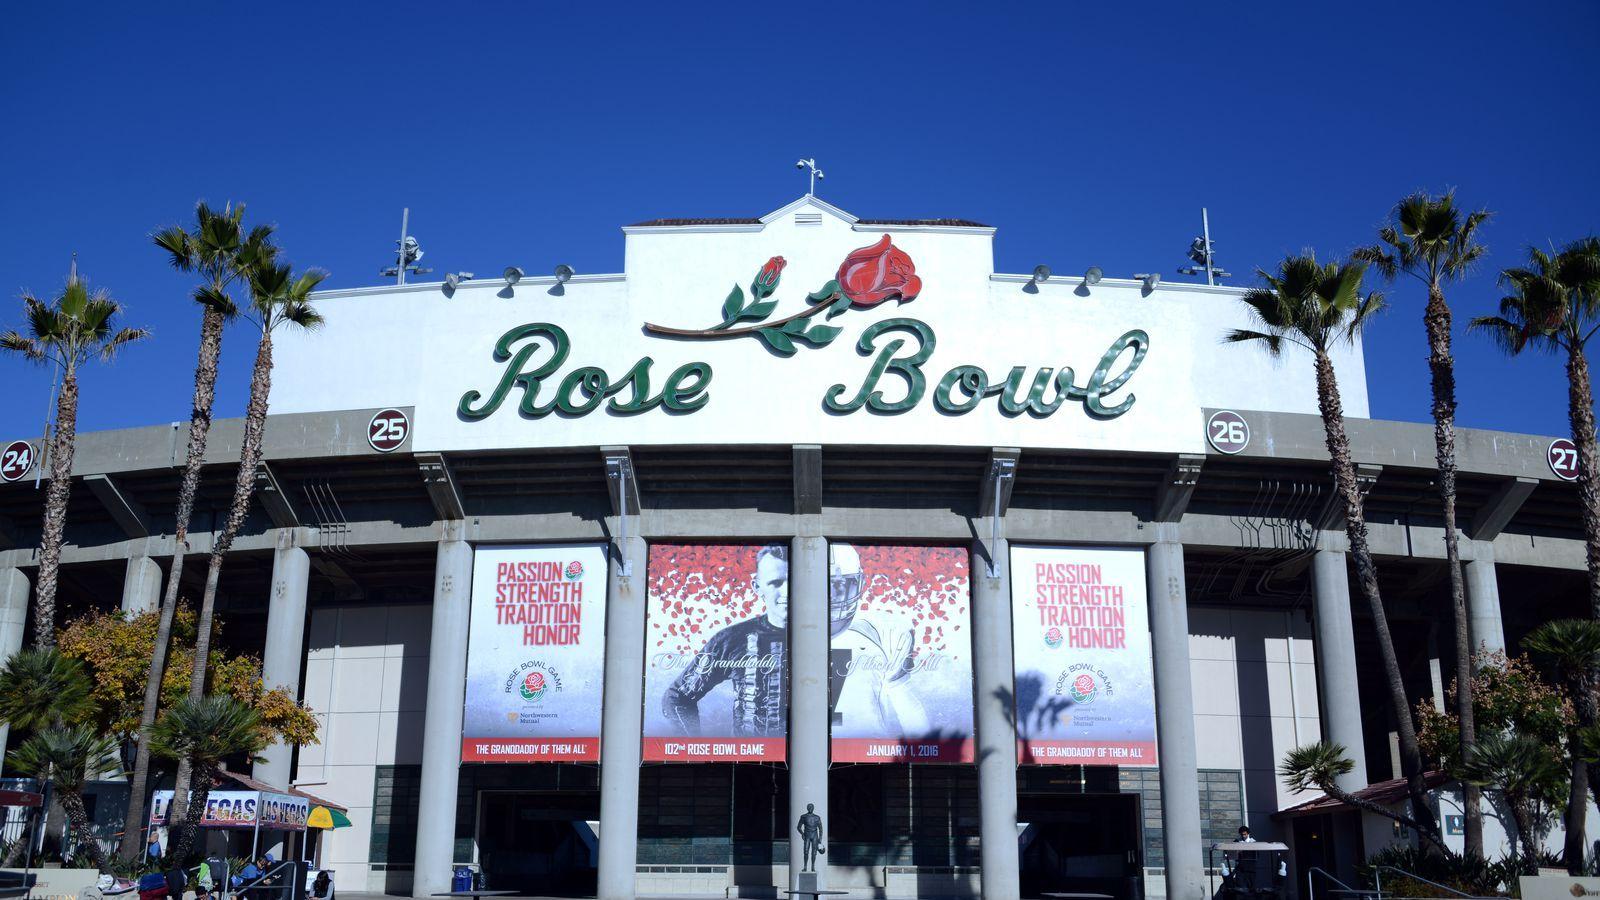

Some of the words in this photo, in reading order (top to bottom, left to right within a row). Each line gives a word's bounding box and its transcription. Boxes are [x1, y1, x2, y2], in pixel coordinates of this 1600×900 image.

[458, 321, 714, 418] Rose
[822, 316, 1150, 418] Bowl
[371, 417, 405, 442] 25
[1211, 420, 1246, 444] 26
[2, 449, 30, 472] 24
[1551, 447, 1578, 471] 27
[496, 561, 563, 583] PASSION
[1035, 563, 1102, 585] PASSION
[495, 582, 582, 604] STRENGTH
[1036, 584, 1124, 606] STRENGTH
[495, 603, 582, 625] TRADITION
[1037, 606, 1125, 628] TRADITION
[523, 624, 580, 646] HONOR
[1068, 627, 1126, 649] HONOR
[505, 668, 521, 694] ROSE
[520, 660, 547, 671] BOWL
[547, 666, 563, 693] GAME
[1055, 671, 1070, 696] ROSE
[1068, 662, 1096, 673] BOWL
[1096, 669, 1114, 696] GAME
[475, 744, 490, 755] THE
[490, 744, 540, 755] GRANDDADDY
[540, 744, 551, 755] OF
[551, 744, 572, 755] THEM
[664, 743, 686, 755] 102nd
[687, 743, 710, 755] ROSE
[712, 743, 738, 755] BOWL
[740, 743, 764, 755] GAME
[866, 745, 908, 757] JANUARY
[909, 745, 916, 758] 1,
[918, 745, 939, 757] 2016
[1031, 747, 1045, 757] THE
[1047, 747, 1096, 758] GRANDDADDY
[1097, 747, 1107, 757] OF
[1108, 747, 1128, 758] THEM
[204, 798, 257, 822] EGAS
[259, 799, 278, 824] LAS
[279, 801, 307, 827] VEGAS
